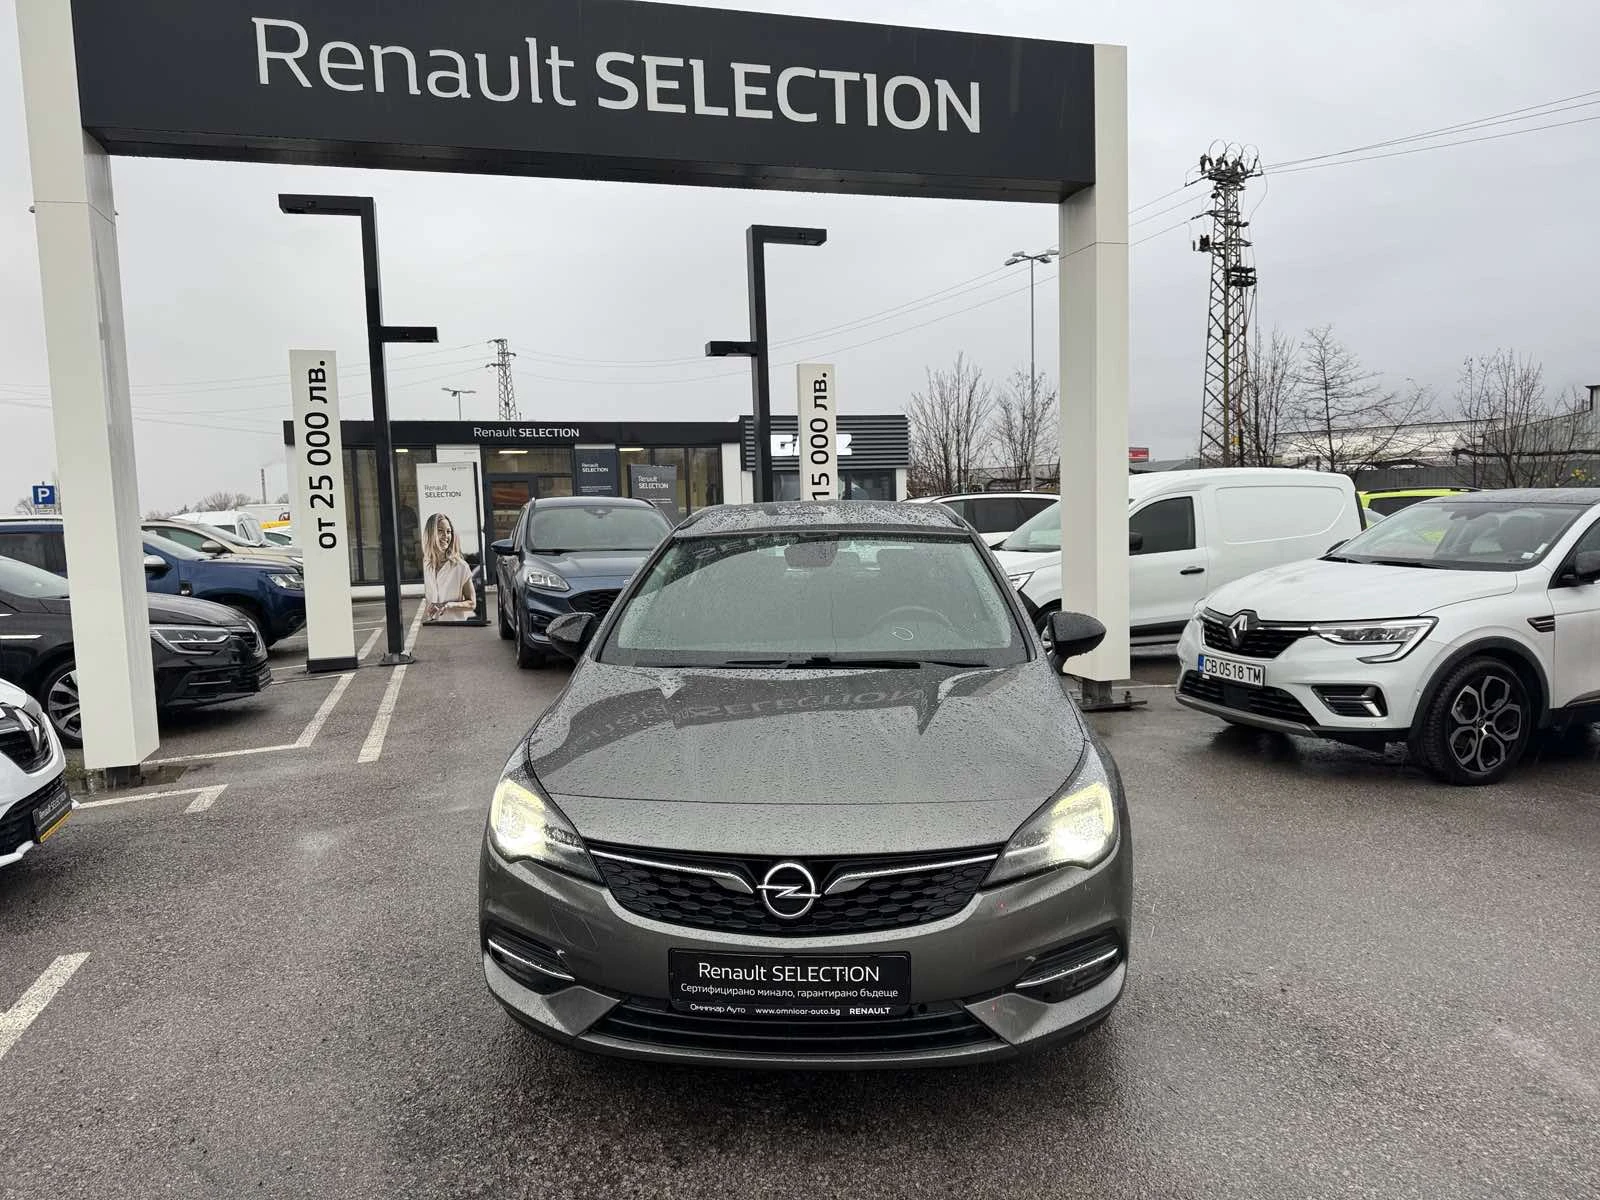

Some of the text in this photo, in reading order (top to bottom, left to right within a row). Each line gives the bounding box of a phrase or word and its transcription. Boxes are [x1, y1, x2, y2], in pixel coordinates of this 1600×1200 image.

[251, 16, 982, 134] Renault SELECTION
[473, 427, 580, 438] Renault SELECTION
[809, 372, 830, 501] 15 000 лв.
[304, 360, 337, 549] от 25 000 лв.
[37, 487, 50, 503] P
[424, 491, 462, 499] SELECTION
[1204, 658, 1262, 684] CB 0518 TM
[698, 962, 880, 983] Renault SELECTION
[680, 982, 899, 999] Сертифицирано минало, гарантирано бъдеще
[849, 1006, 891, 1016] RENAULT
